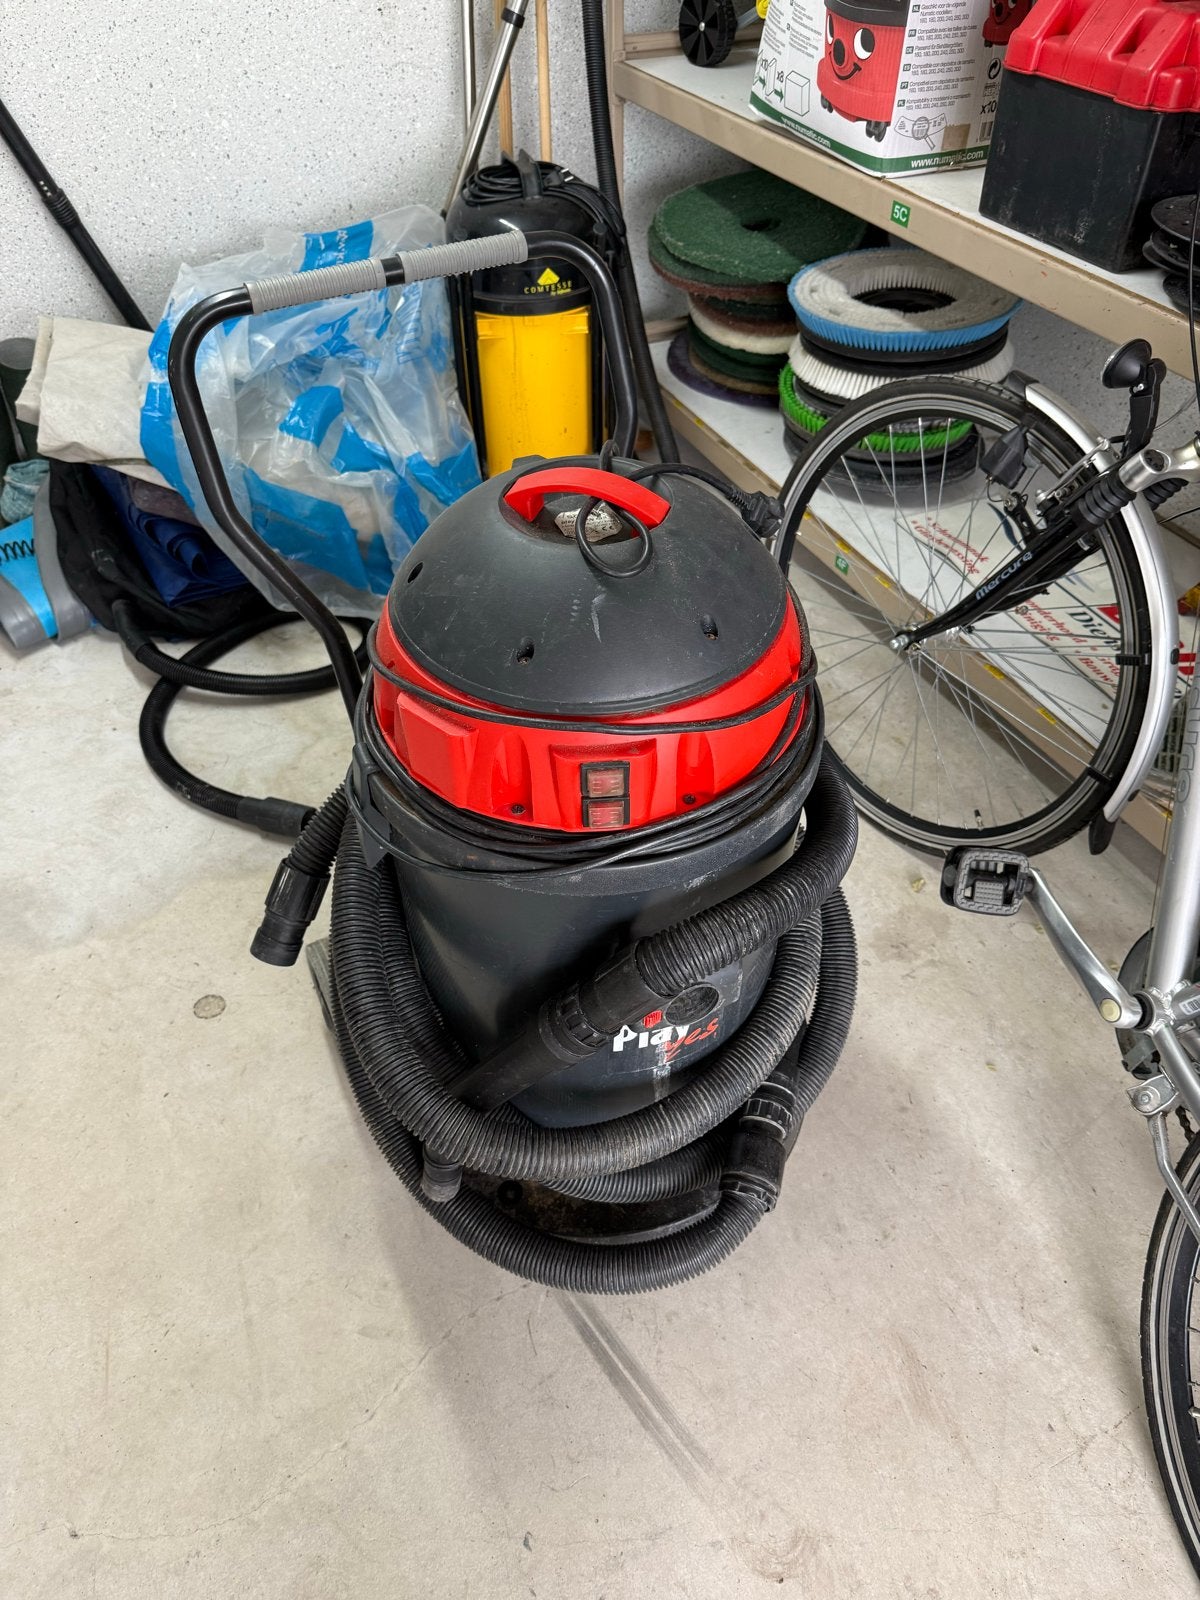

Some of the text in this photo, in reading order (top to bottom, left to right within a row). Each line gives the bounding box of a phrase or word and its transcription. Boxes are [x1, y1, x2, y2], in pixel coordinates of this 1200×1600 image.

[911, 150, 984, 168] www.numatic.com
[893, 204, 908, 222] 5C
[524, 280, 572, 294] COMTESSE
[975, 551, 1033, 600] mercure
